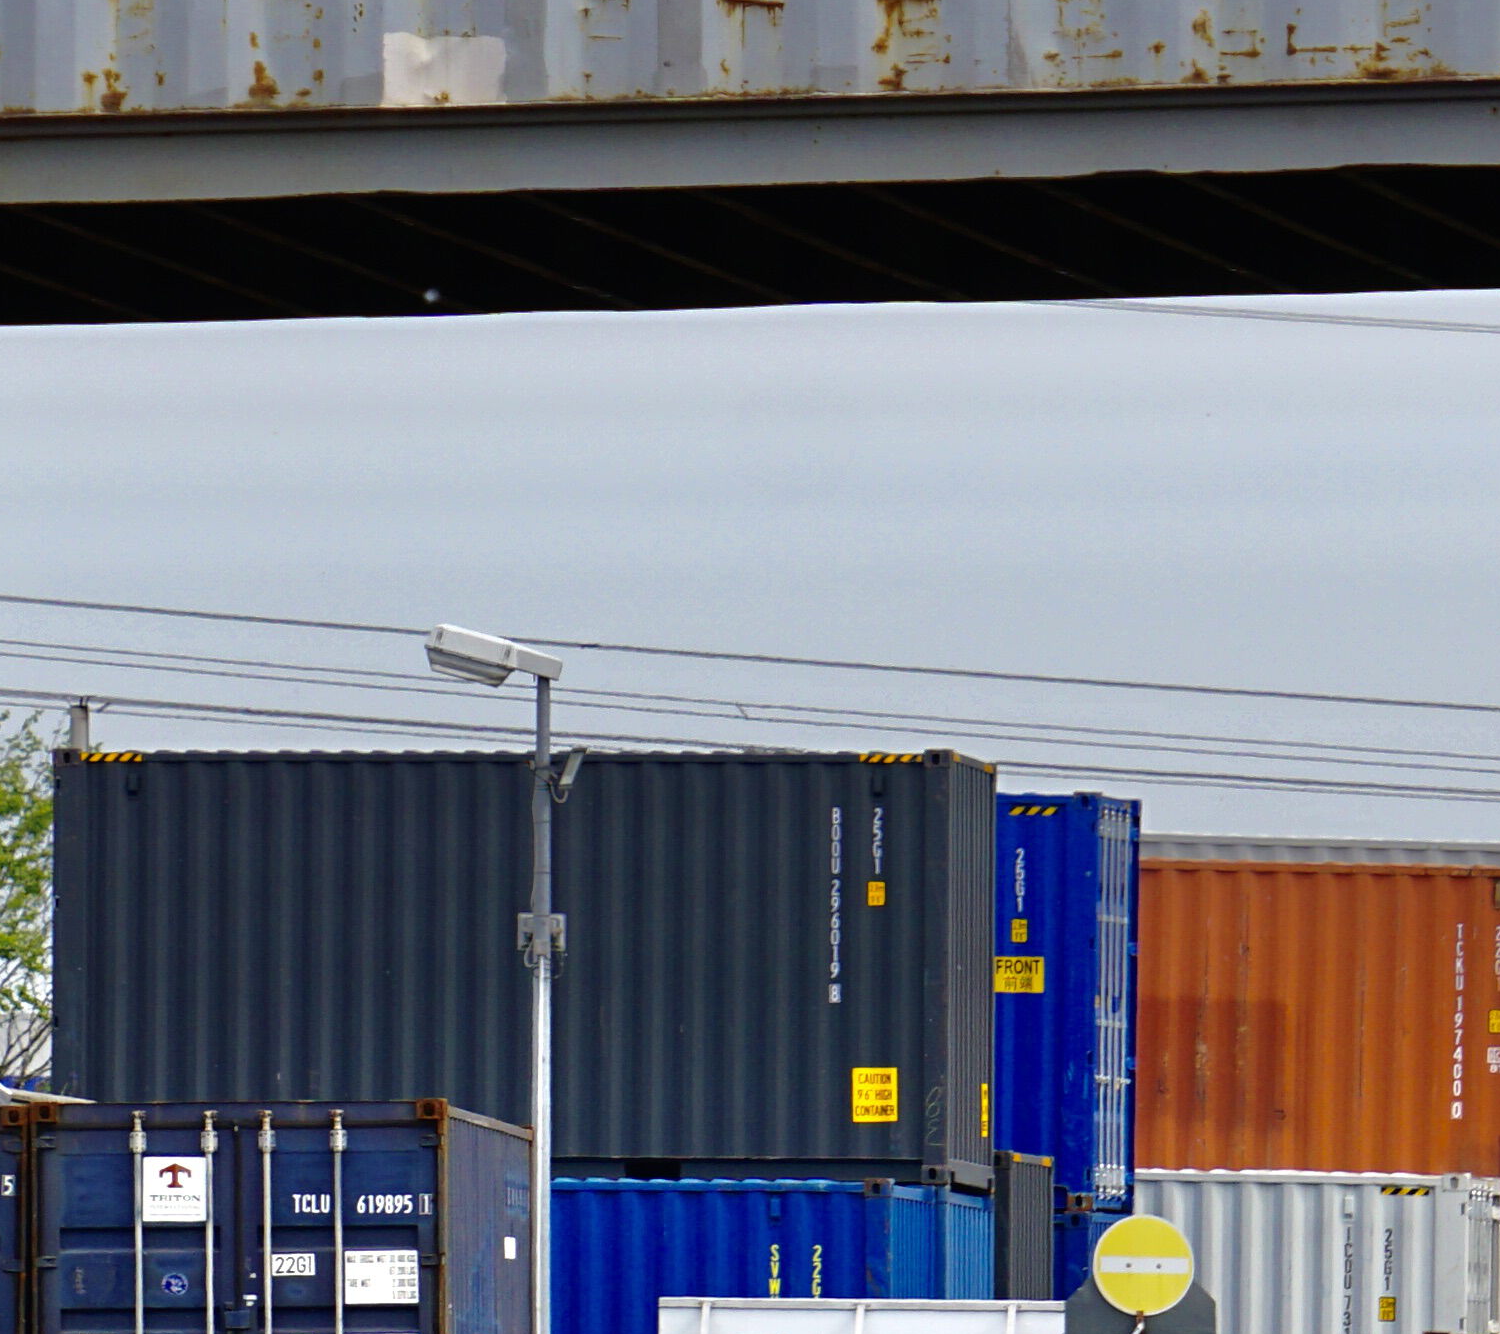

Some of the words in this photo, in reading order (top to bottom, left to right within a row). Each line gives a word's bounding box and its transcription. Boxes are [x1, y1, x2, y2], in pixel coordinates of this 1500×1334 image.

[872, 807, 883, 875] 25G1
[1015, 847, 1025, 913] 25G1
[830, 879, 841, 979] 296019
[995, 959, 1041, 975] FRONT
[1455, 923, 1464, 992] TCKU
[831, 984, 840, 1002] 8
[1453, 995, 1464, 1097] 197400
[858, 1073, 892, 1085] CAUTION
[875, 1089, 893, 1100] HIGH
[854, 1105, 895, 1116] CONTAINER
[2, 1175, 15, 1195] 5
[150, 1194, 201, 1202] TRITON
[292, 1193, 331, 1214] TCLU
[356, 1193, 413, 1214] 619895
[274, 1256, 313, 1275] 22G1
[1384, 1228, 1393, 1291] 25G1
[769, 1244, 781, 1298] SVW
[812, 1244, 822, 1298] 22G
